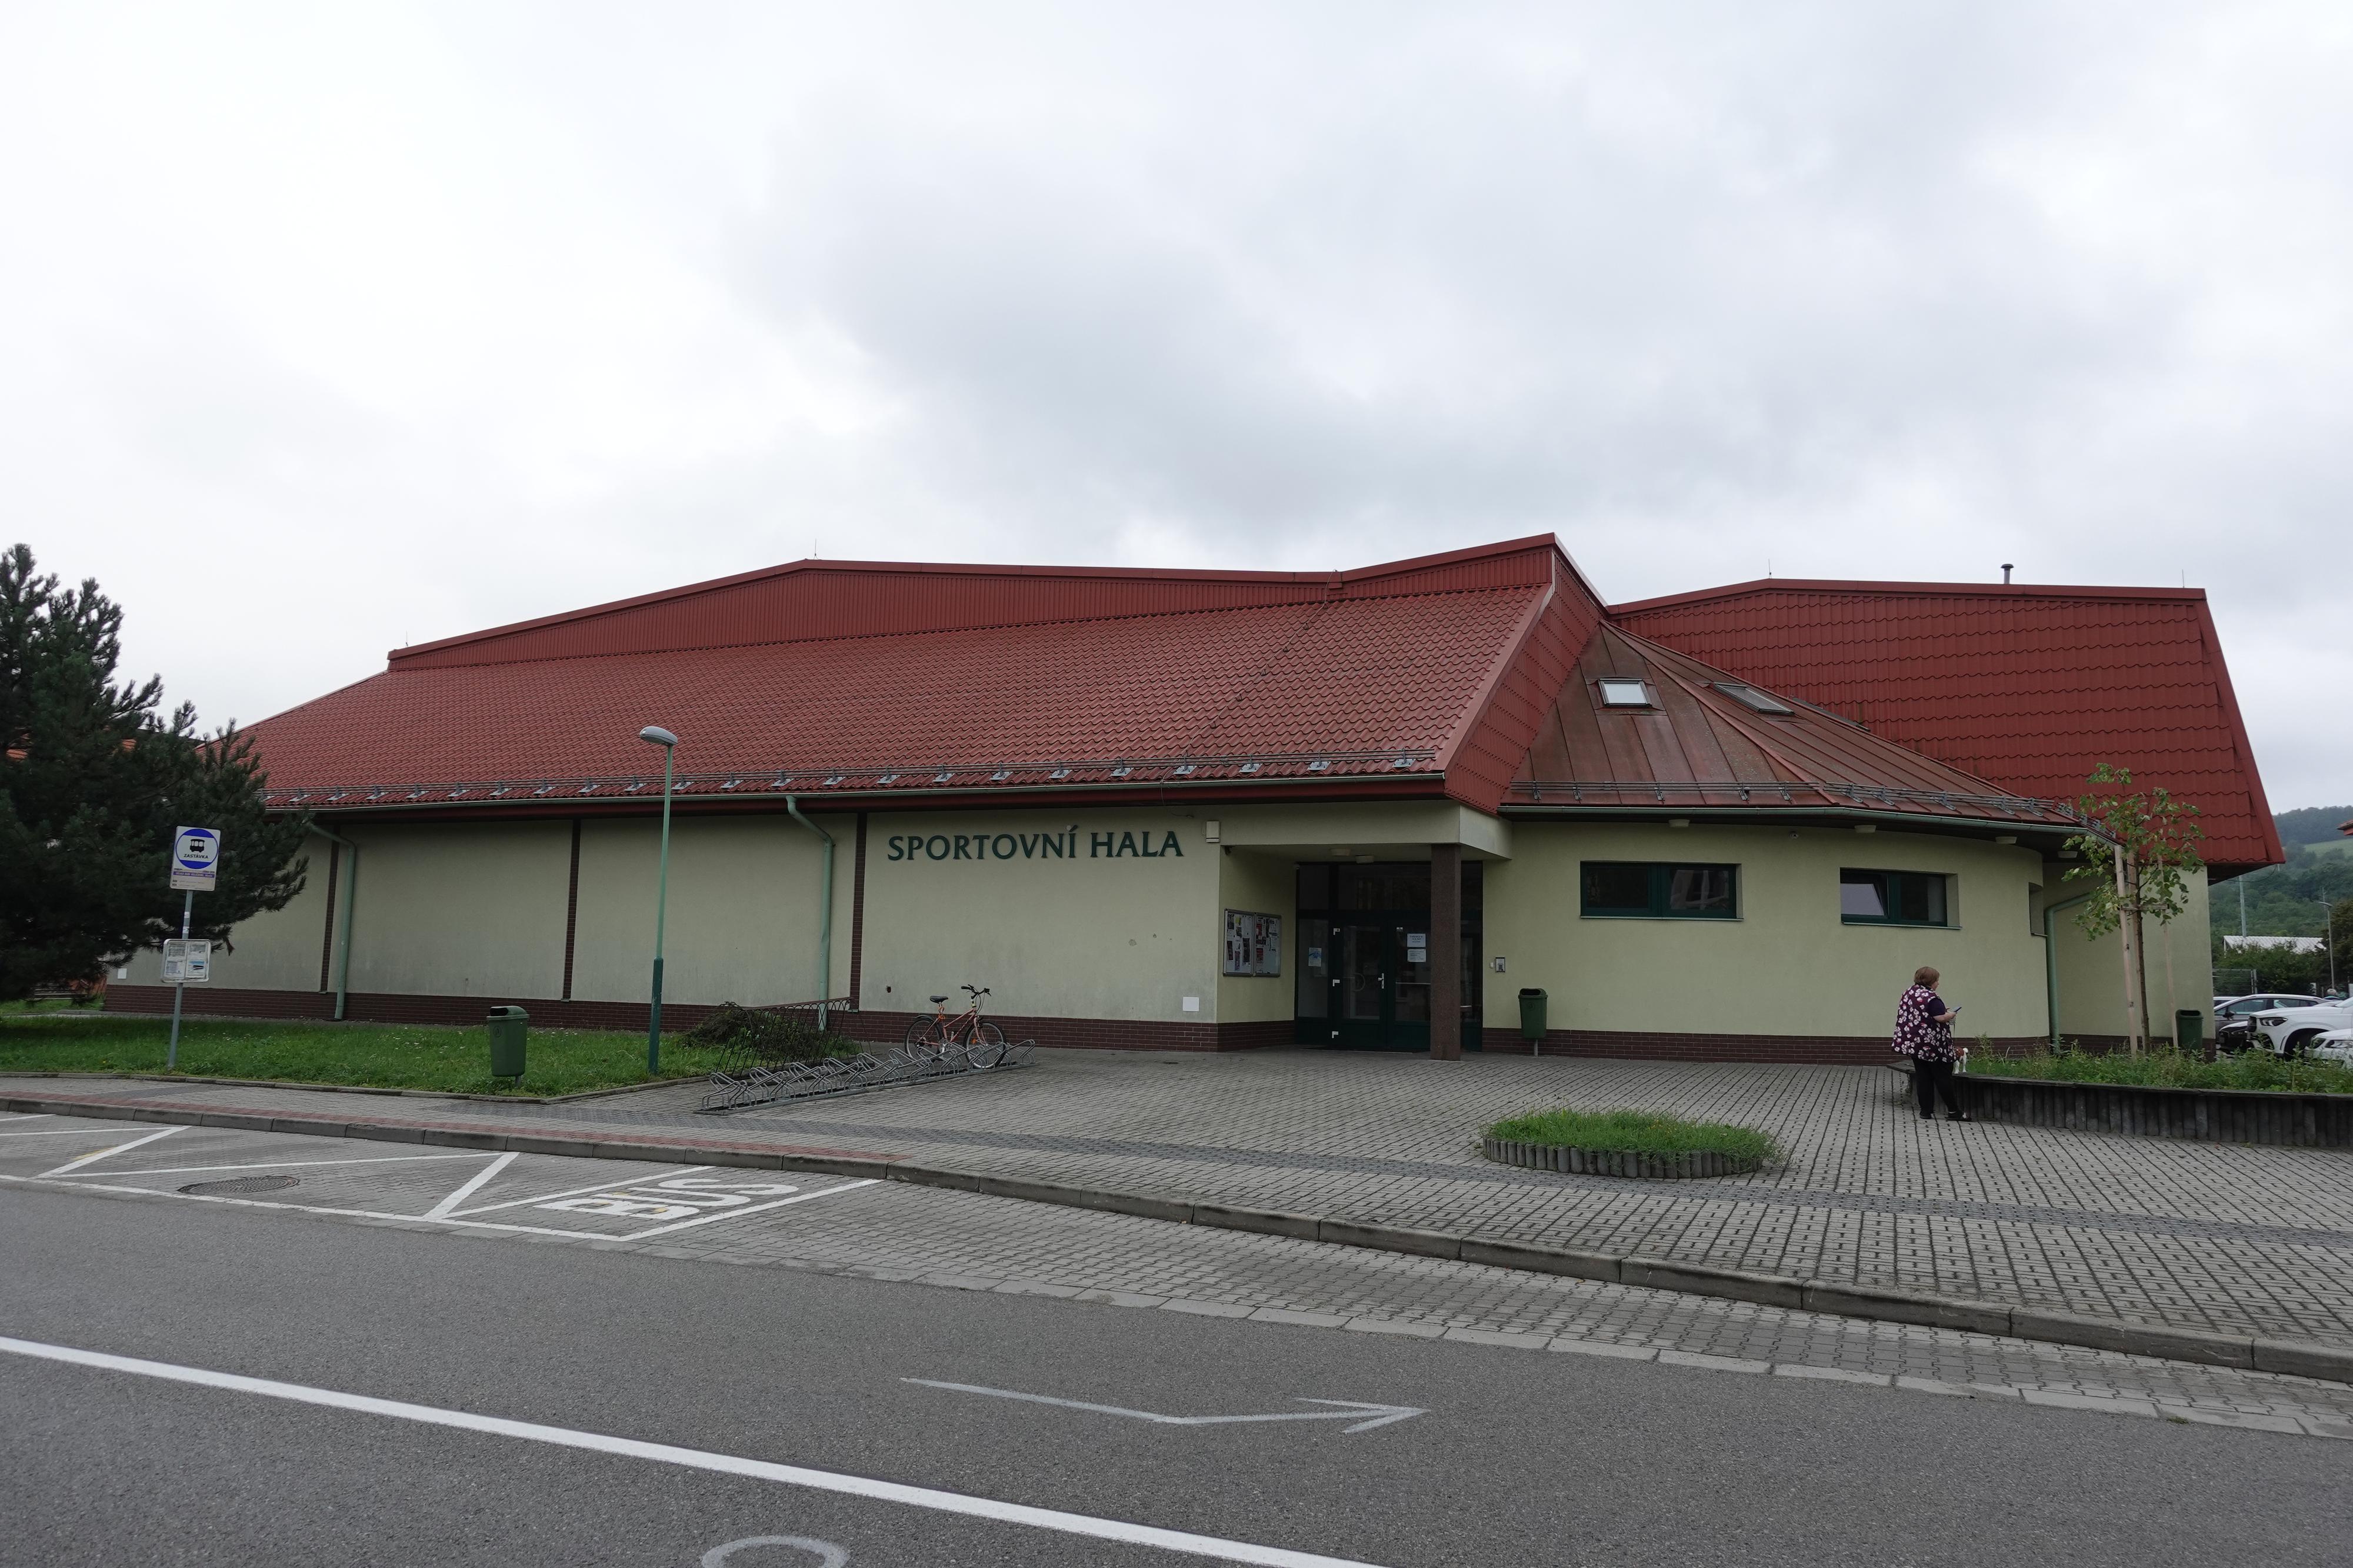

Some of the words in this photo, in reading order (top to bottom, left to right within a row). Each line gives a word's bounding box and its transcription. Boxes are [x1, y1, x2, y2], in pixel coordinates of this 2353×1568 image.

[887, 825, 1078, 861] SPORTOVNÍ
[1089, 830, 1185, 858] HALA
[532, 1179, 799, 1220] BUS
